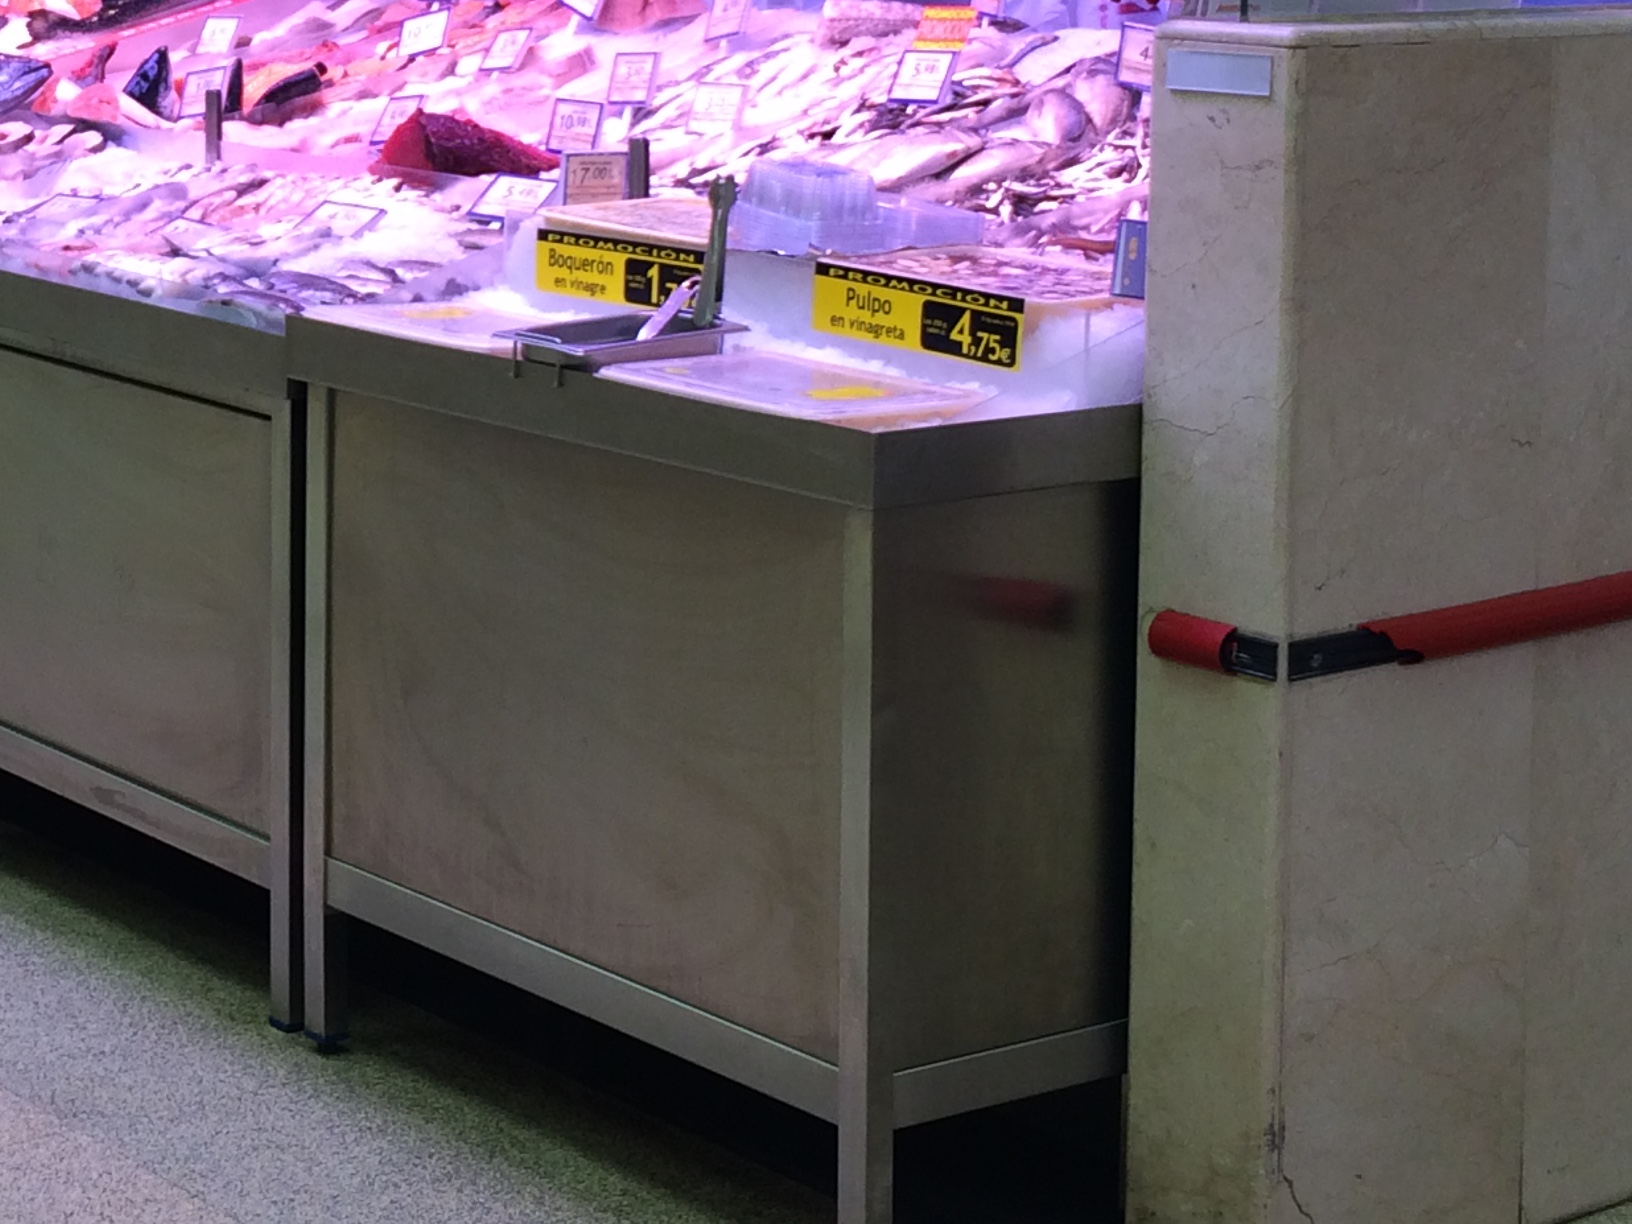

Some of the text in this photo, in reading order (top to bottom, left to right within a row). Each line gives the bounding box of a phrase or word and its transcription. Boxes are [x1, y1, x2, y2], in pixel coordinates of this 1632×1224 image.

[547, 233, 695, 263] PROMOCIÓN
[548, 248, 614, 276] Boquerón
[554, 276, 607, 296] en vinagre
[828, 267, 1008, 310] PROMOCIÓN
[845, 287, 892, 318] Pulpo
[830, 314, 845, 328] en
[849, 316, 905, 341] vinagreta
[949, 309, 1011, 363] 4,75€
